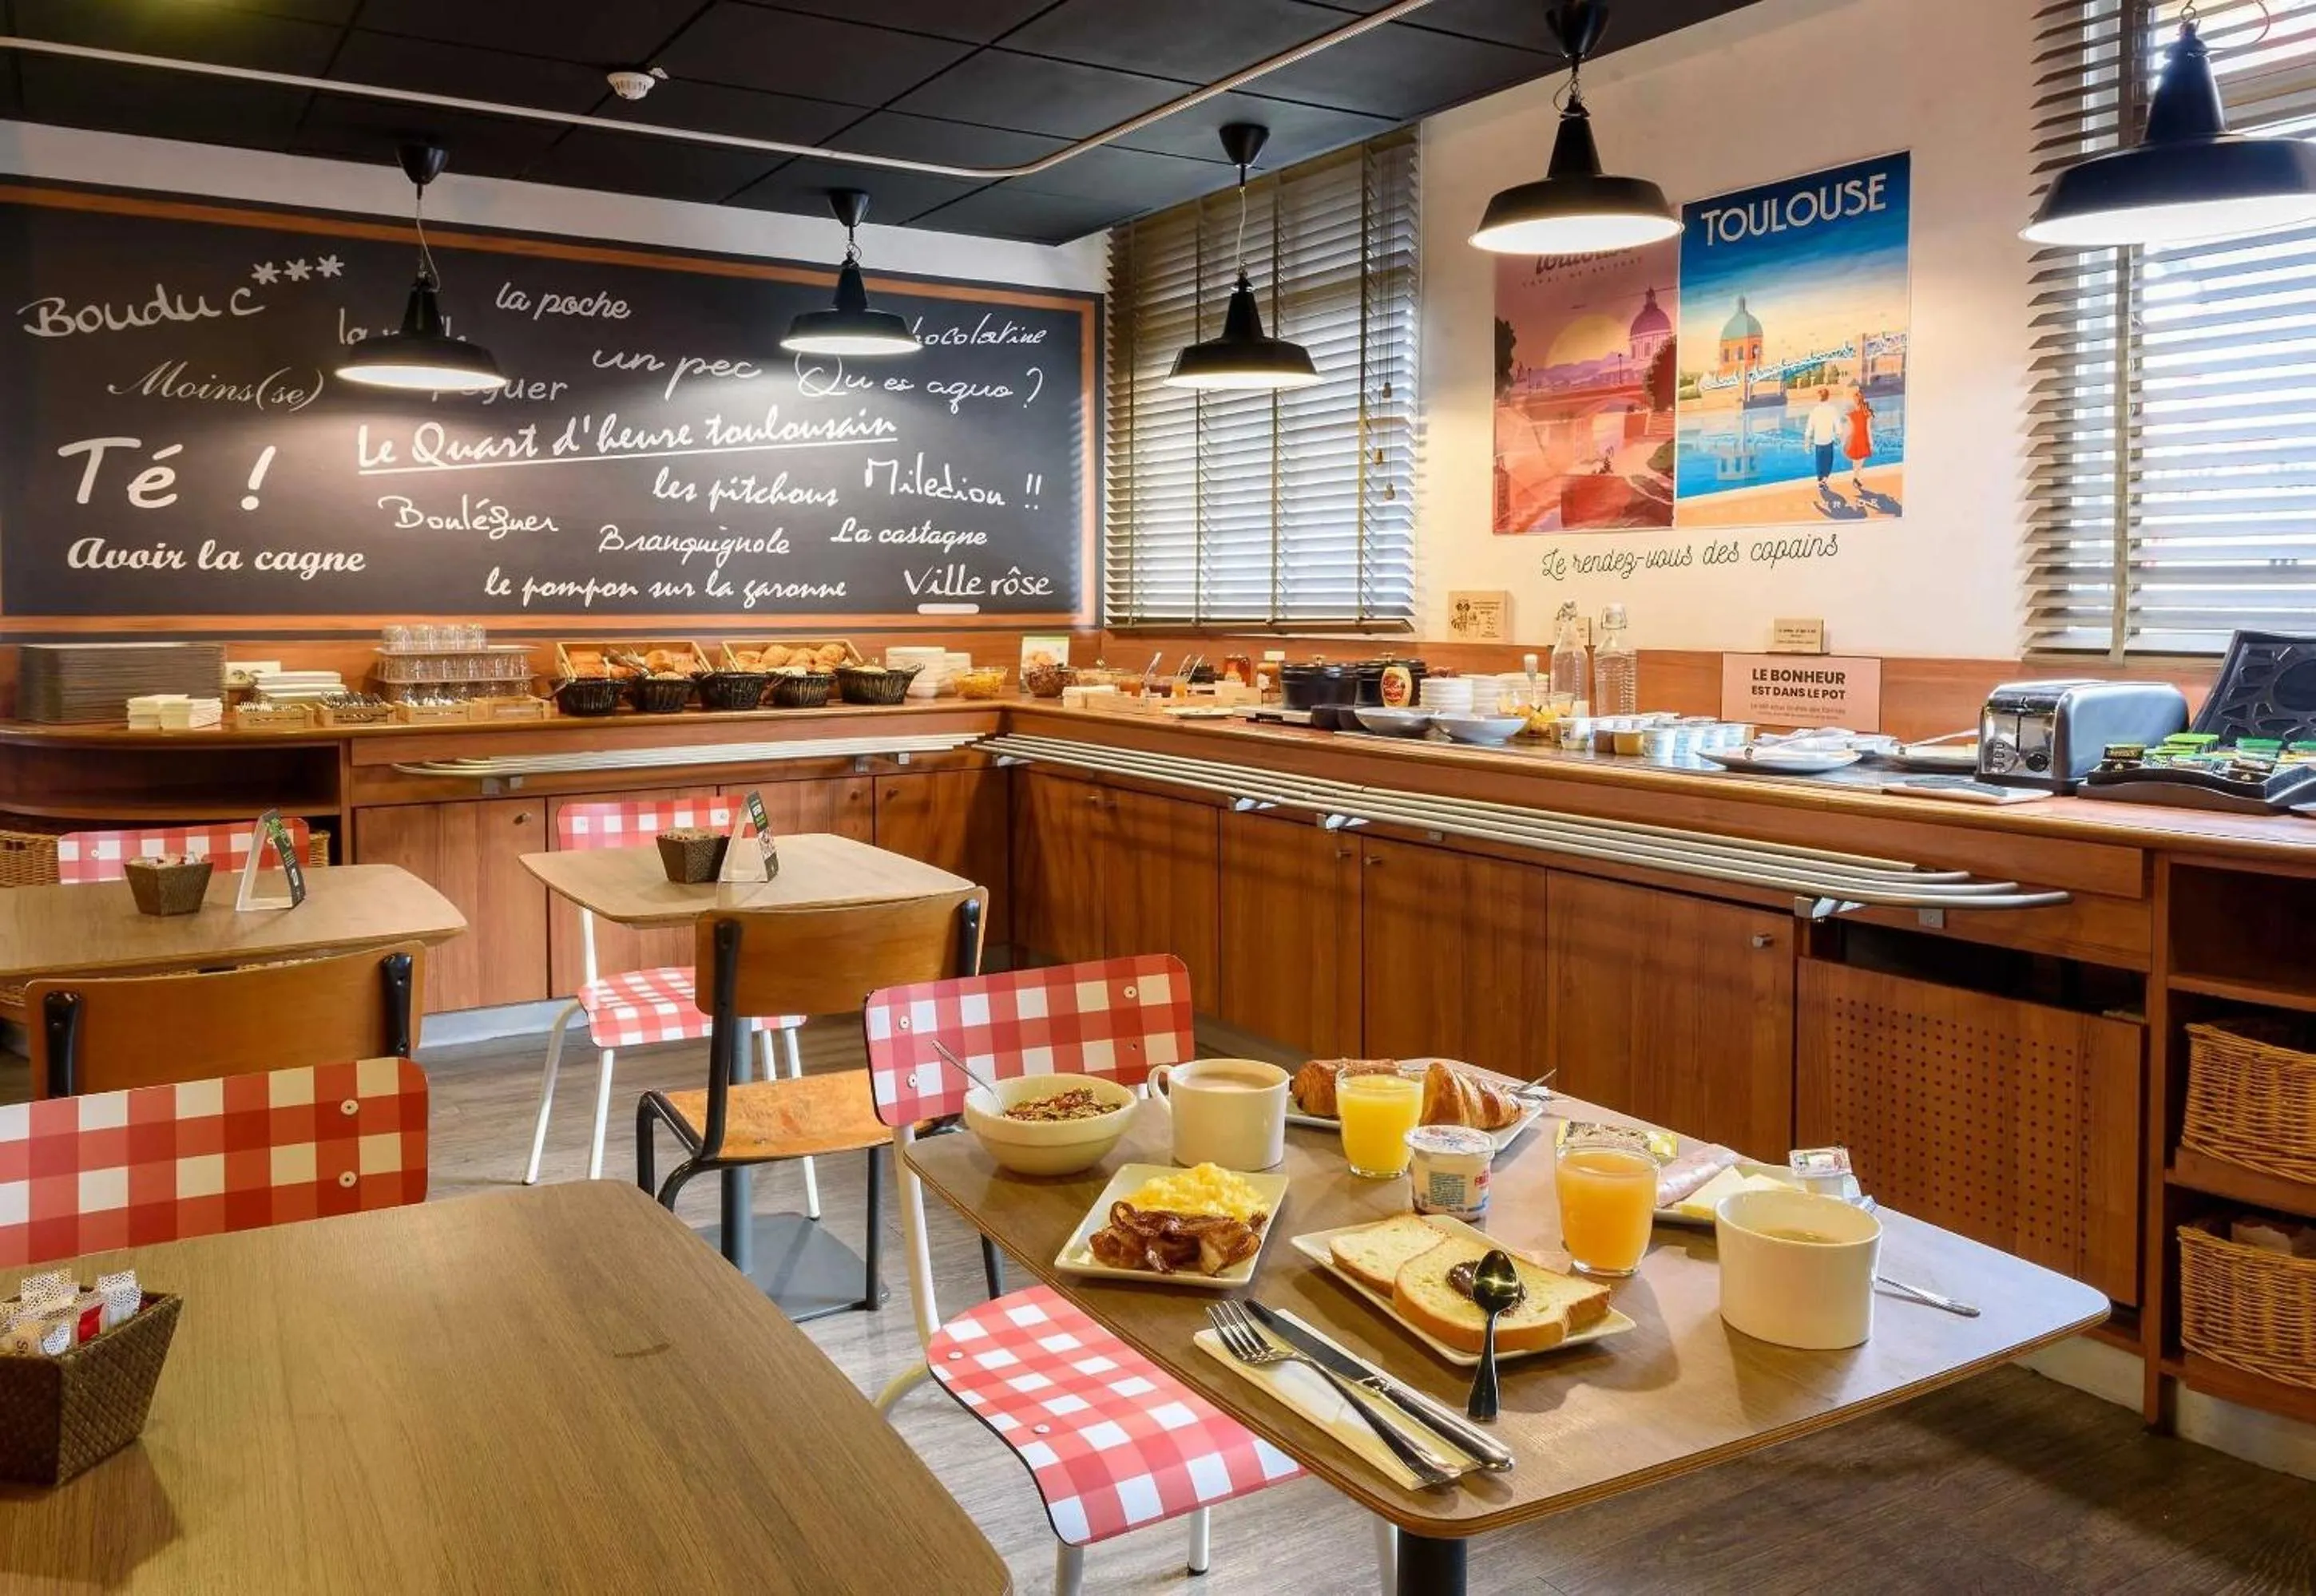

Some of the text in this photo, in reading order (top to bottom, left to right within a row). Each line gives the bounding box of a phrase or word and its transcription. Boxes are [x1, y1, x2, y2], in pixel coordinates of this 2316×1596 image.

[1701, 172, 1888, 245] TOULOUSE
[496, 282, 631, 320] la poche
[912, 312, 1047, 345] hocolatine
[108, 360, 324, 411] Moins(se)
[592, 349, 761, 401] un pec
[926, 381, 1013, 414] aquo
[1023, 367, 1043, 408] ?
[358, 406, 898, 468] Le Quart d'heure toulousain
[58, 436, 276, 511] Té !
[652, 466, 839, 513] les pitchous
[1025, 473, 1041, 509] !!
[378, 494, 559, 541] Bouléguer
[831, 517, 987, 553] La castagne
[67, 537, 366, 581] Avoir la cagne
[598, 525, 790, 568] Branquignole
[1541, 533, 1839, 581] Le rendez-vous des copains
[484, 567, 847, 609] le pompon sur la garonne
[903, 564, 1053, 596] Ville rôse
[1751, 685, 1846, 700] EST DANS LE POT
[1752, 667, 1846, 685] LE BONHEUR
